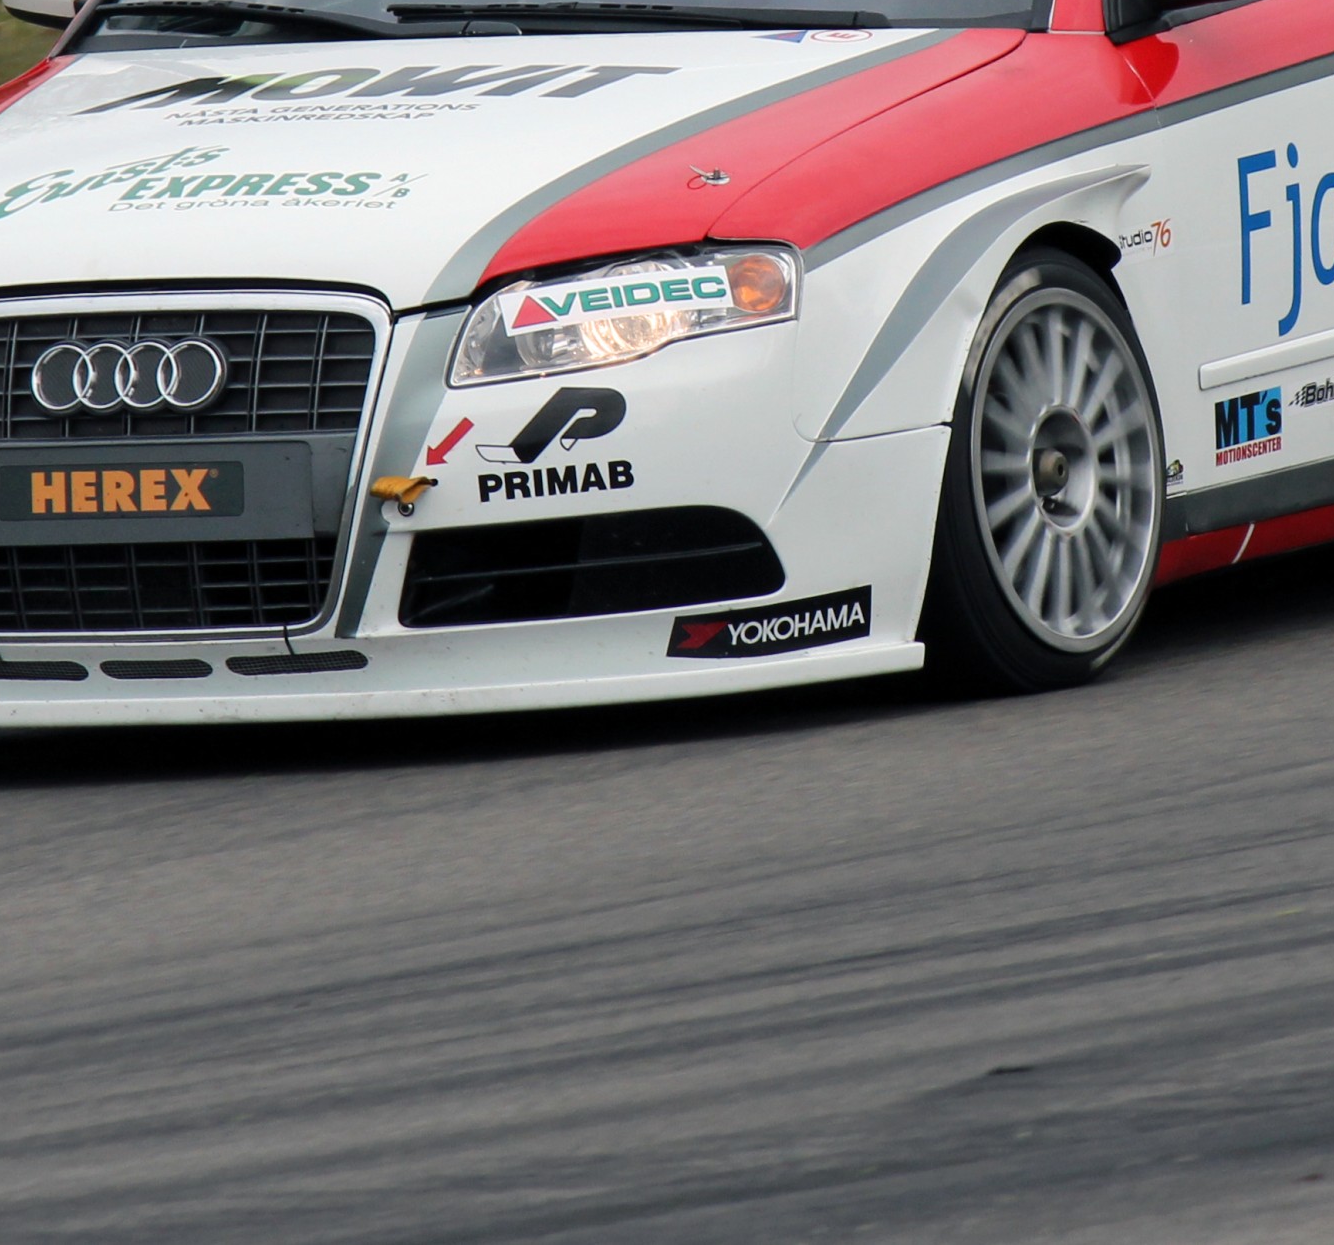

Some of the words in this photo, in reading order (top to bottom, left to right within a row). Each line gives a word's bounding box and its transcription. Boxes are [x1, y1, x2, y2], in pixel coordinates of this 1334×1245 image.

[73, 64, 681, 115] MOWIT
[178, 112, 436, 127] MASKINREDSKAP
[270, 103, 482, 115] GENERATIONS
[108, 200, 165, 213] Det
[172, 197, 271, 212] gröna
[281, 196, 397, 210] åkeriet
[117, 171, 383, 202] EXPRESS
[539, 274, 728, 317] VEIDEC
[1215, 436, 1282, 467] MOTIONSCENTER
[31, 468, 212, 514] HEREX
[477, 460, 635, 503] PRIMAB
[727, 602, 866, 647] YOKOHAMA
